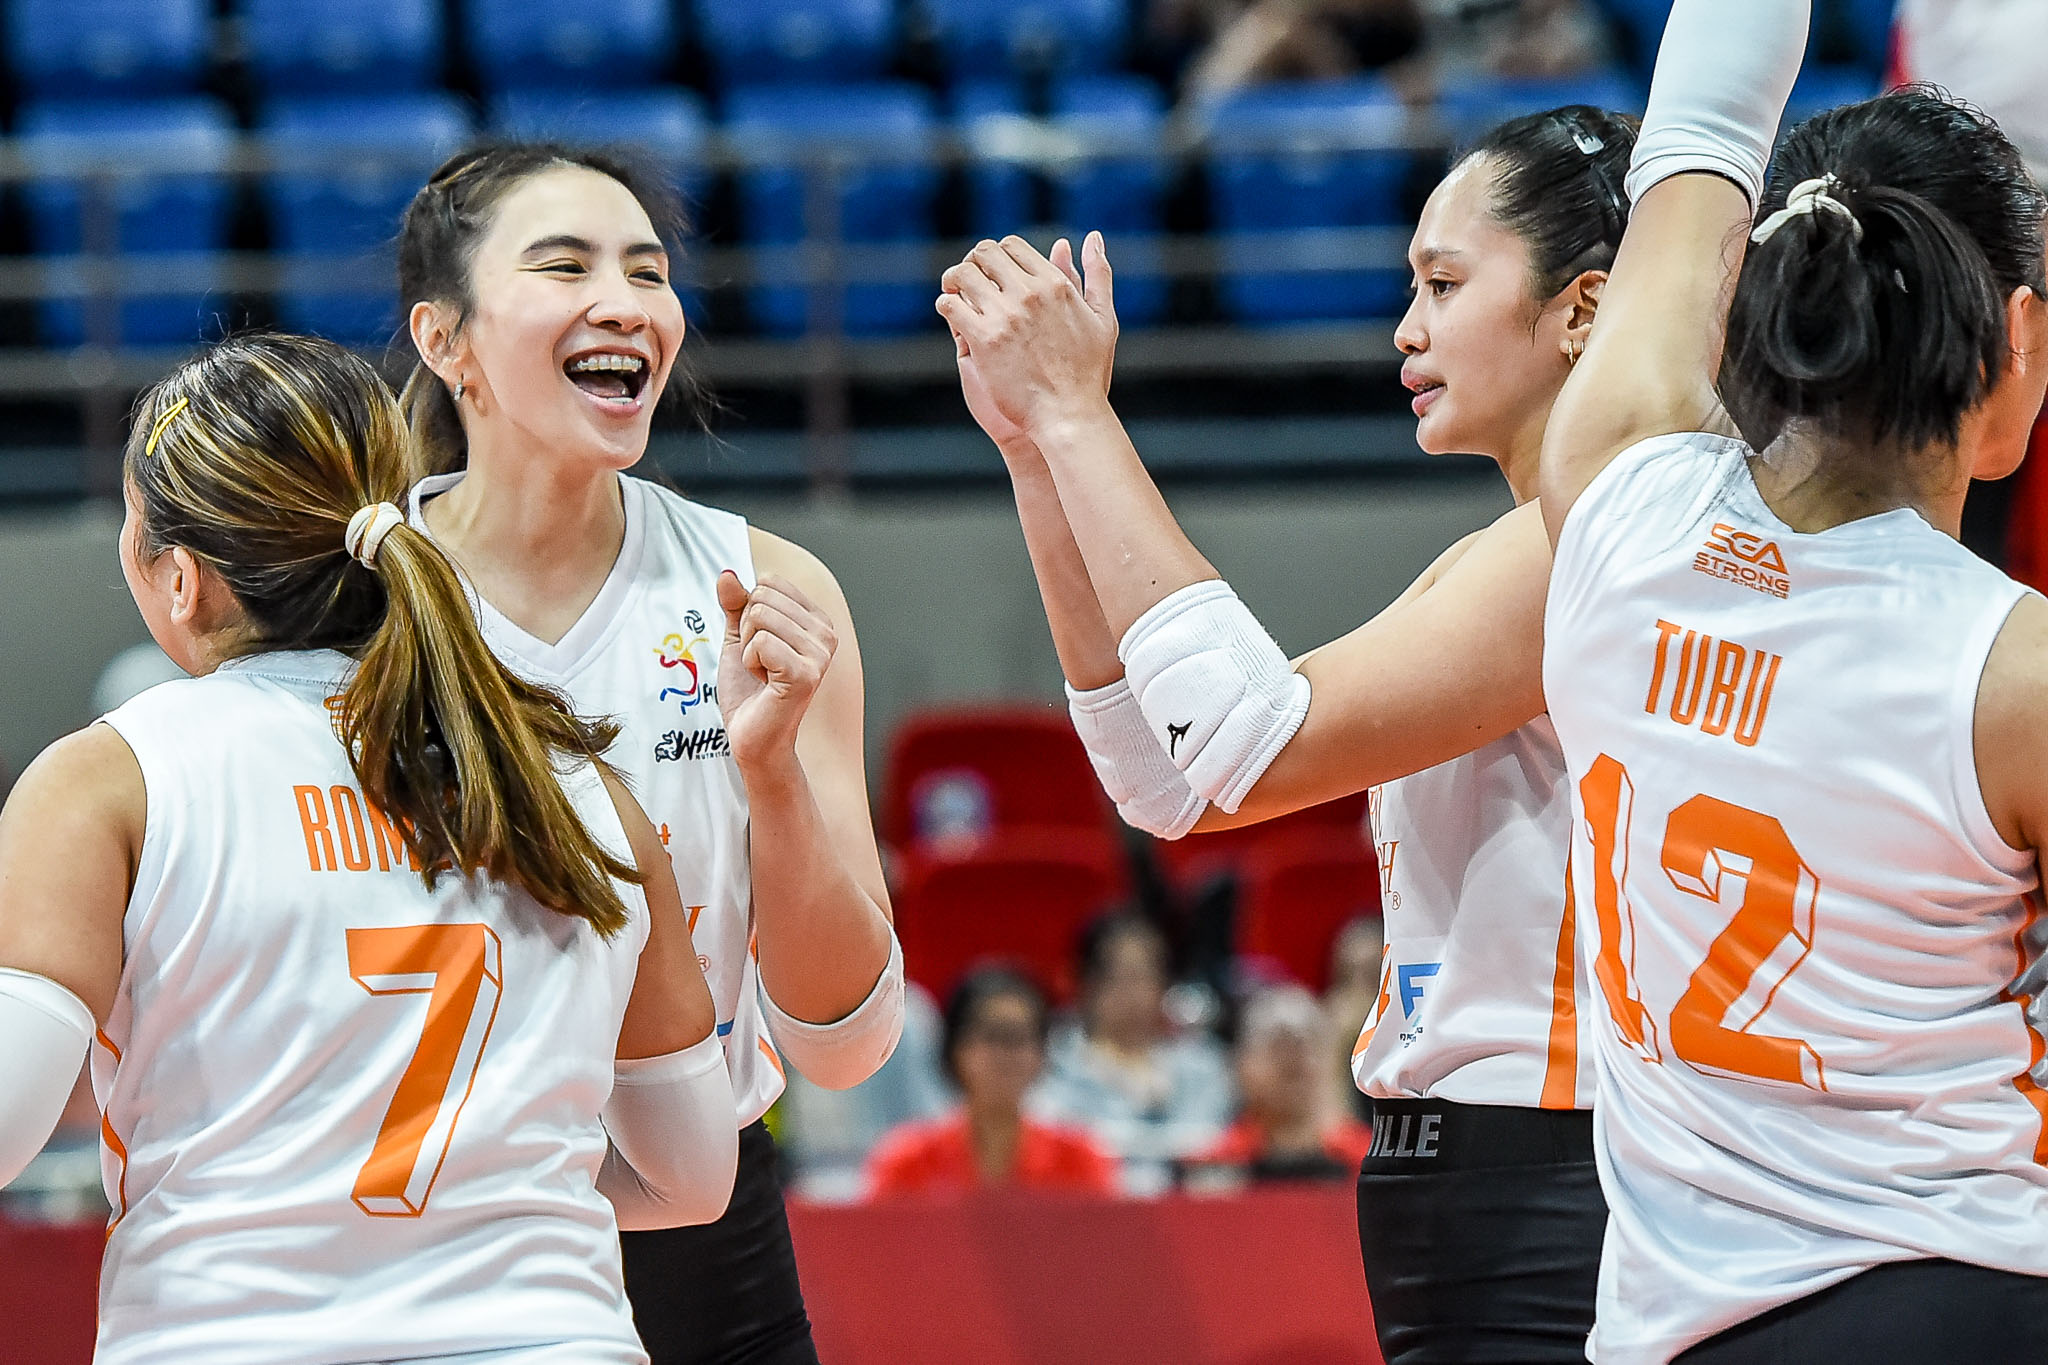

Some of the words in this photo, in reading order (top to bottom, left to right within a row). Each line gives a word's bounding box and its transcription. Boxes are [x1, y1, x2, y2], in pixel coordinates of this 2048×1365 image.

[1694, 552, 1791, 592] STRONG
[1704, 523, 1789, 575] SGA
[1645, 619, 1783, 747] TUBU
[293, 785, 485, 872] ROM
[1579, 752, 1828, 1092] 12
[345, 923, 503, 1217] 7
